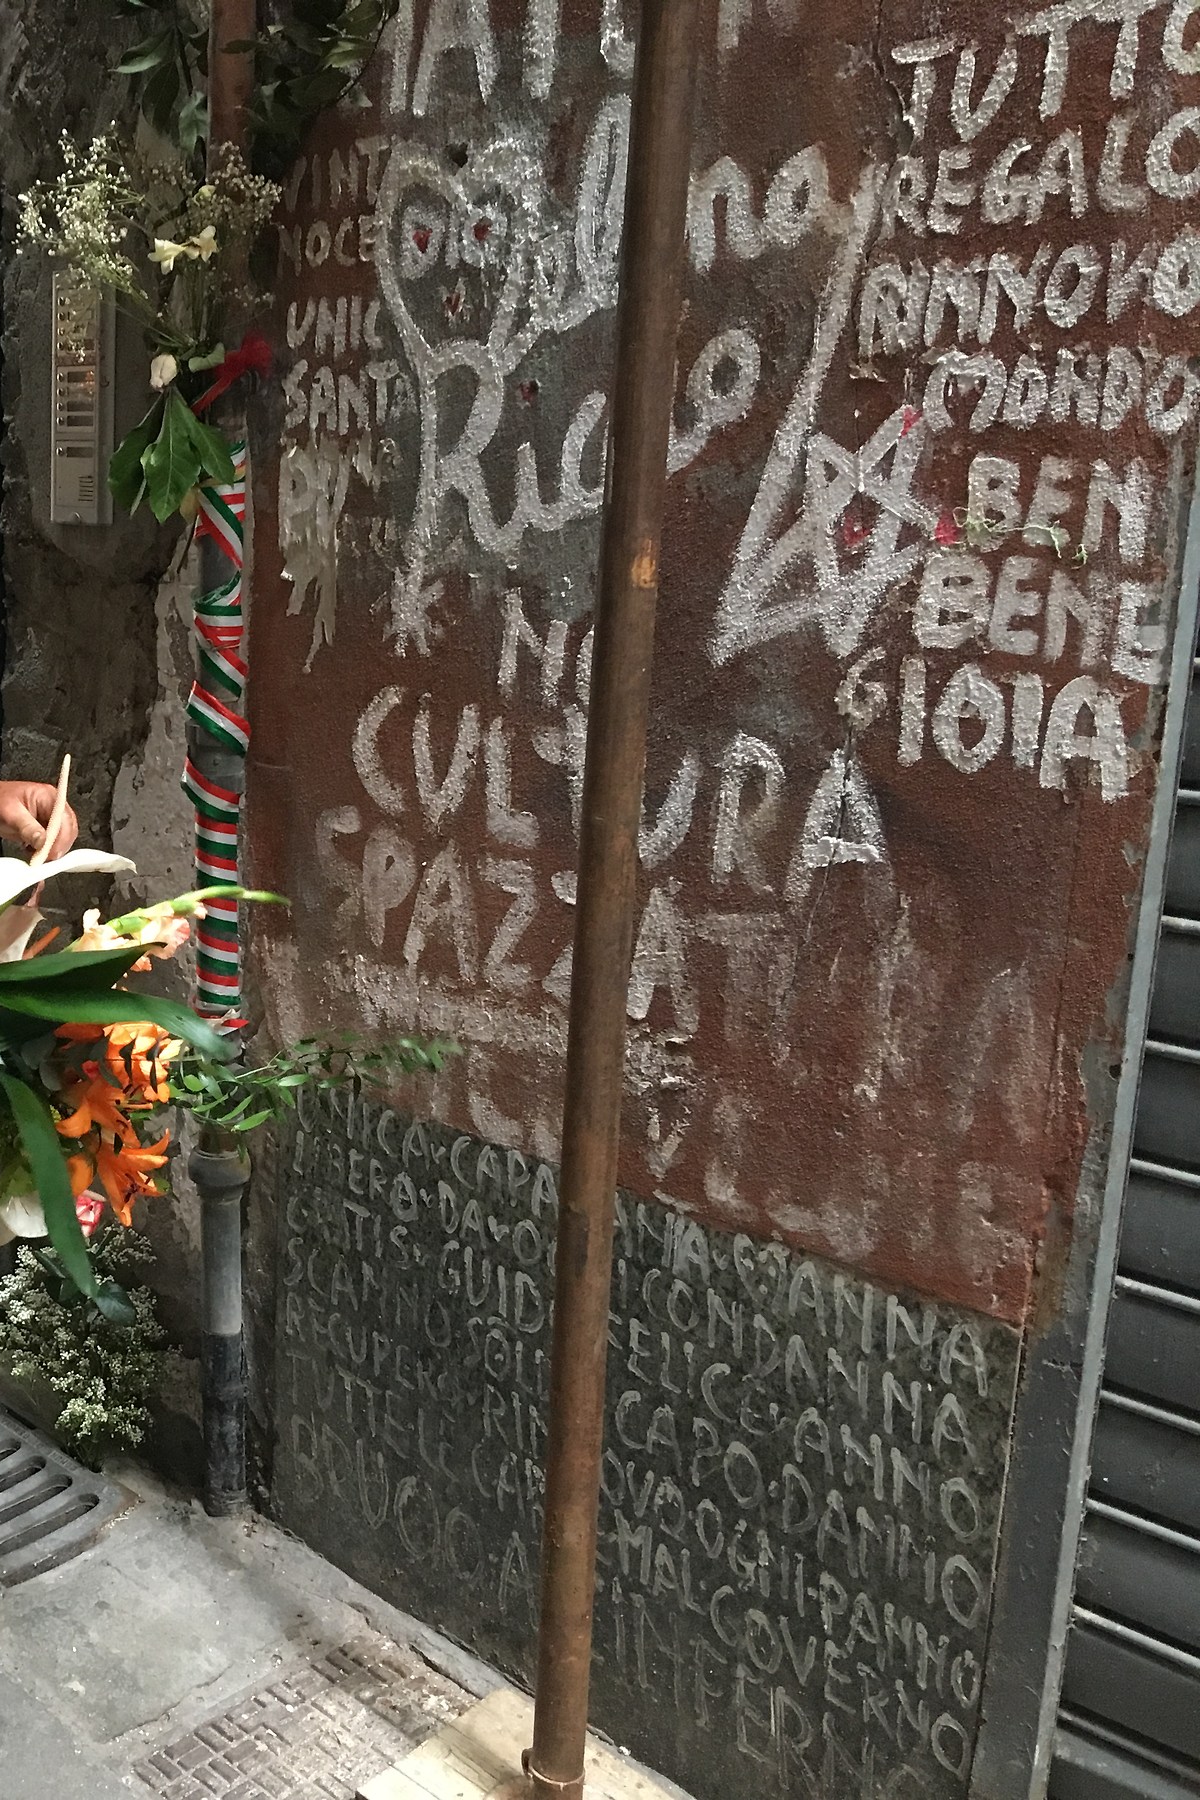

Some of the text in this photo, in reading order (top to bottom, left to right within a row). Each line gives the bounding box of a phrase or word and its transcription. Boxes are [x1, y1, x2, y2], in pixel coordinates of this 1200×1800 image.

[882, 106, 1200, 237] REGALO
[922, 345, 1199, 434] MONDO
[967, 451, 1153, 566] BEN
[912, 552, 1166, 685] BENE
[835, 646, 1129, 804] GIOIA
[438, 1180, 487, 1250] DA
[643, 1268, 978, 1464] CONDANNA
